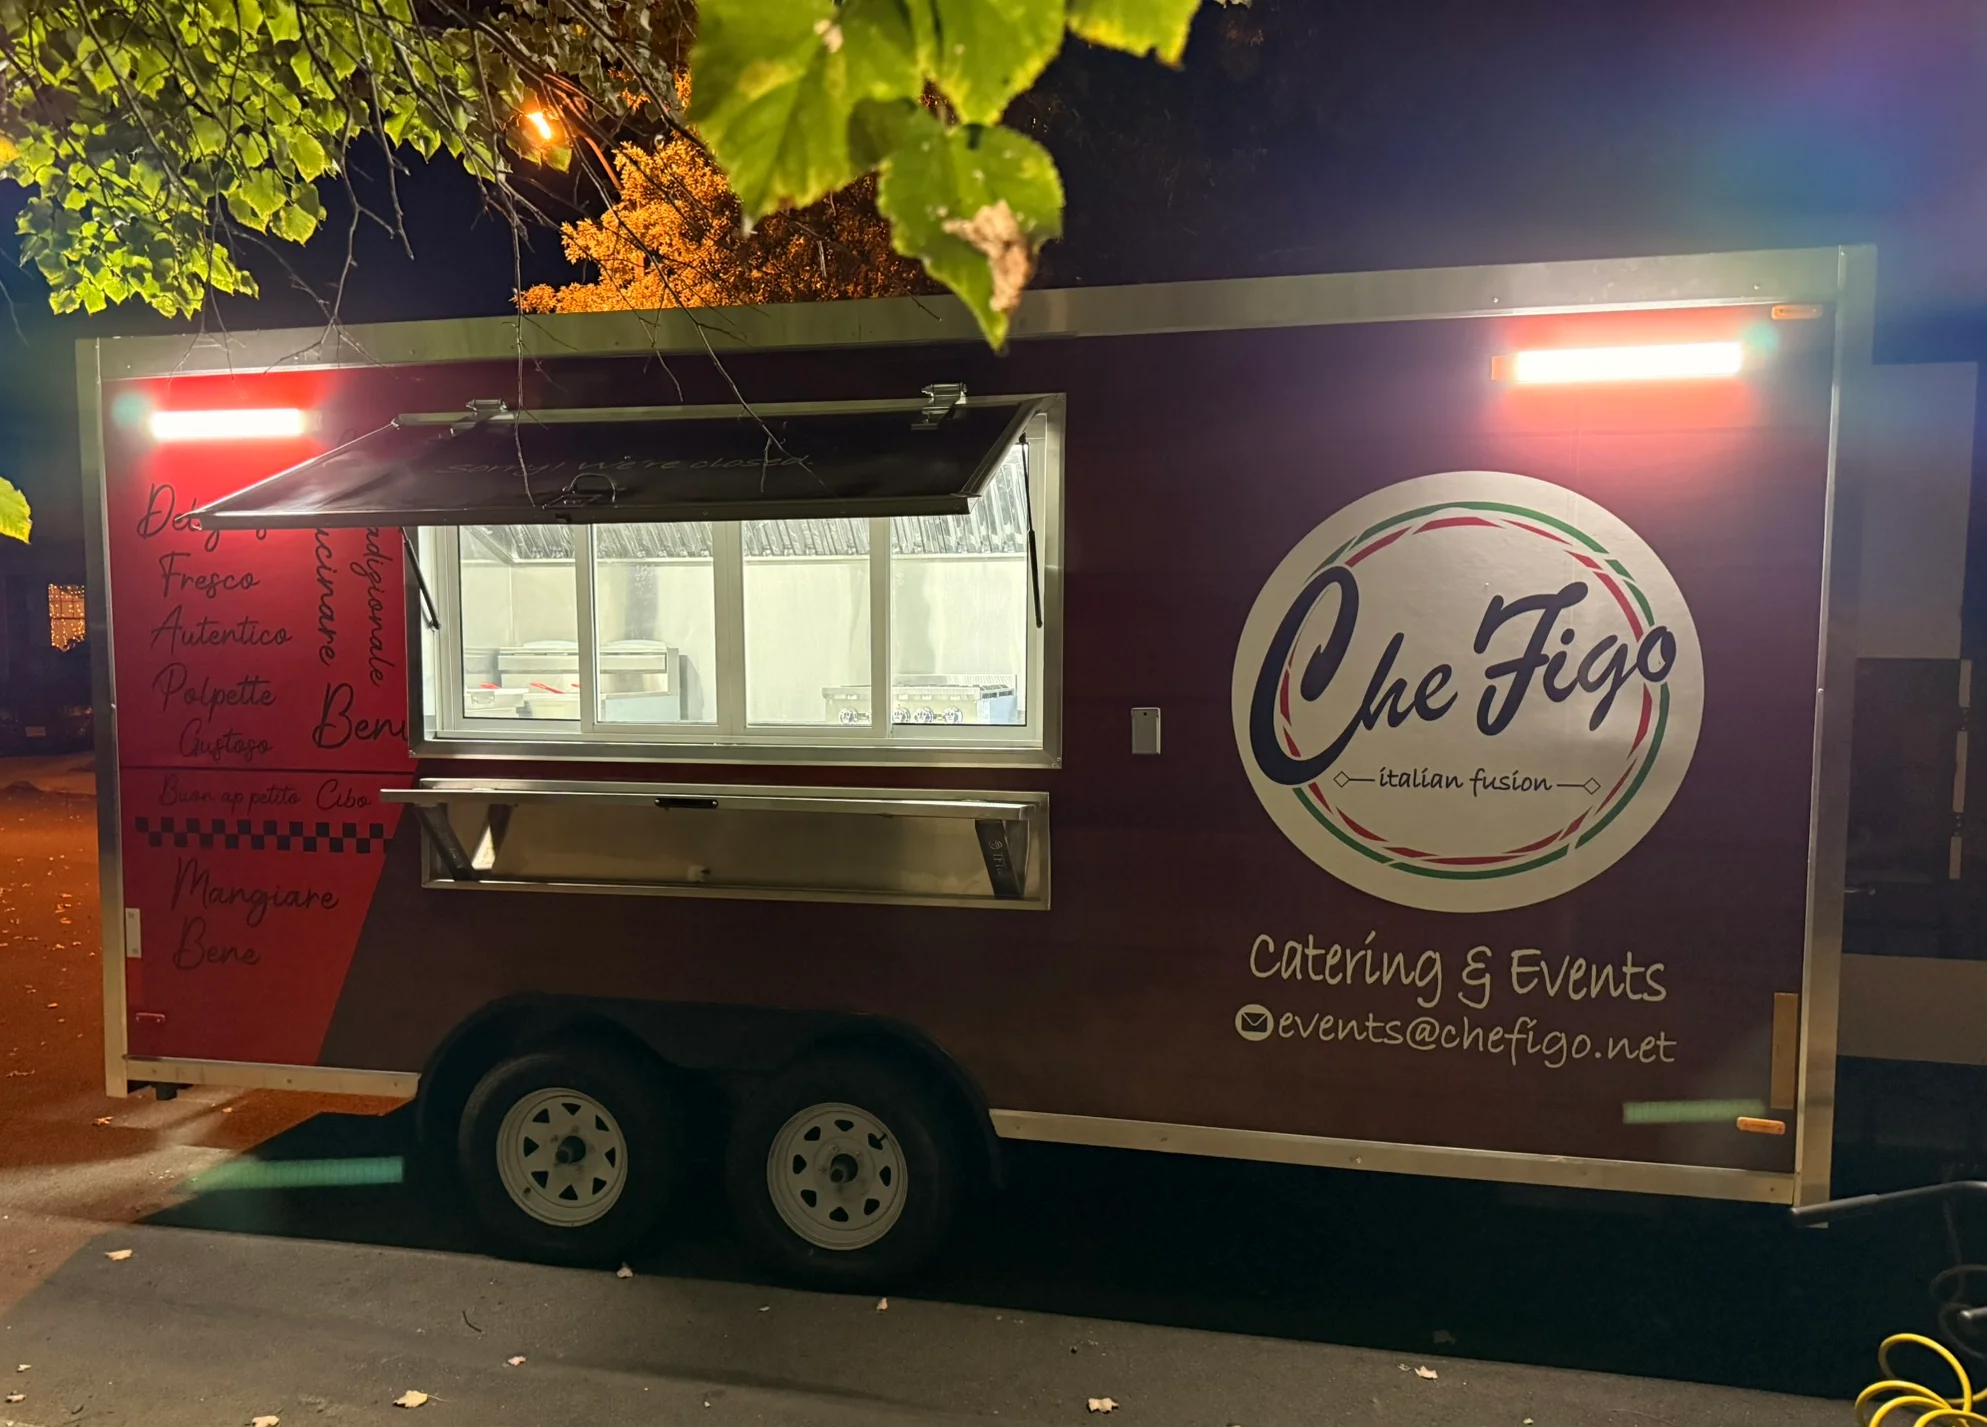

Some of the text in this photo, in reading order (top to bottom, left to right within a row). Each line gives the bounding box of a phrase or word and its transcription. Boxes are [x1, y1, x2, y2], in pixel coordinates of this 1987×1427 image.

[158, 550, 260, 599] Fresco
[151, 605, 292, 654] Autentico
[152, 662, 276, 722] Polpette
[1249, 566, 1677, 786] Che Figo
[179, 717, 273, 761] Gustoso
[158, 772, 215, 807] Buon
[316, 779, 371, 811] Cibo
[1379, 766, 1553, 798] italian fusion
[171, 857, 339, 928] Mangiare
[172, 916, 260, 970] Bene
[1249, 930, 1668, 1009] Catering & Events
[1278, 1010, 1677, 1068] events@chefigo.net
